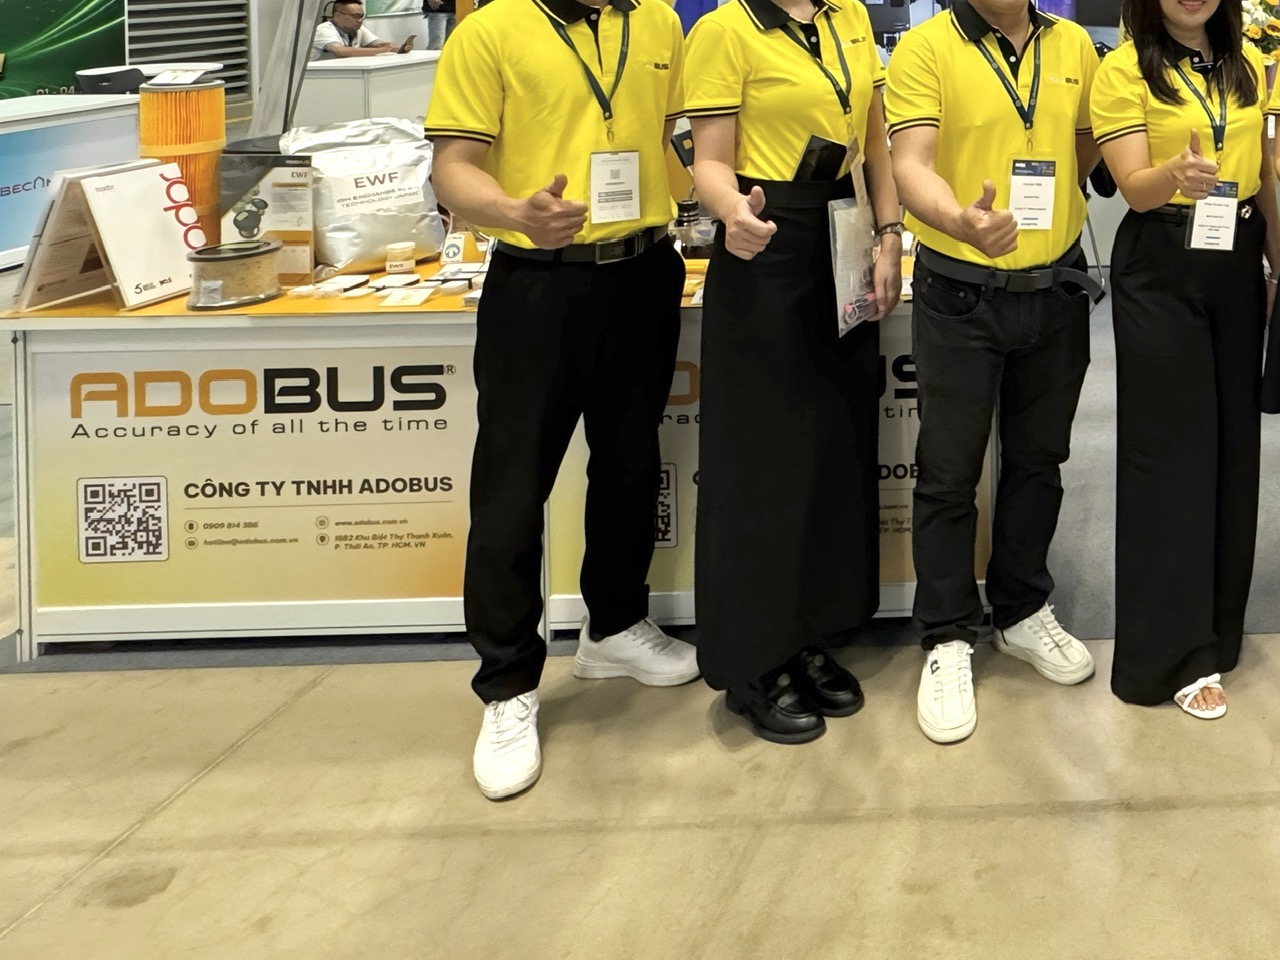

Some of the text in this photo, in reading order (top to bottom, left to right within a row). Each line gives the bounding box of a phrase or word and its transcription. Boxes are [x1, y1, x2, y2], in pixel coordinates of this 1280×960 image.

[354, 171, 399, 189] EWF
[69, 364, 447, 419] ADOBUS
[71, 416, 448, 439] Accuracy of all the time
[184, 476, 453, 498] CÔNG TY TNHH ADOBUS
